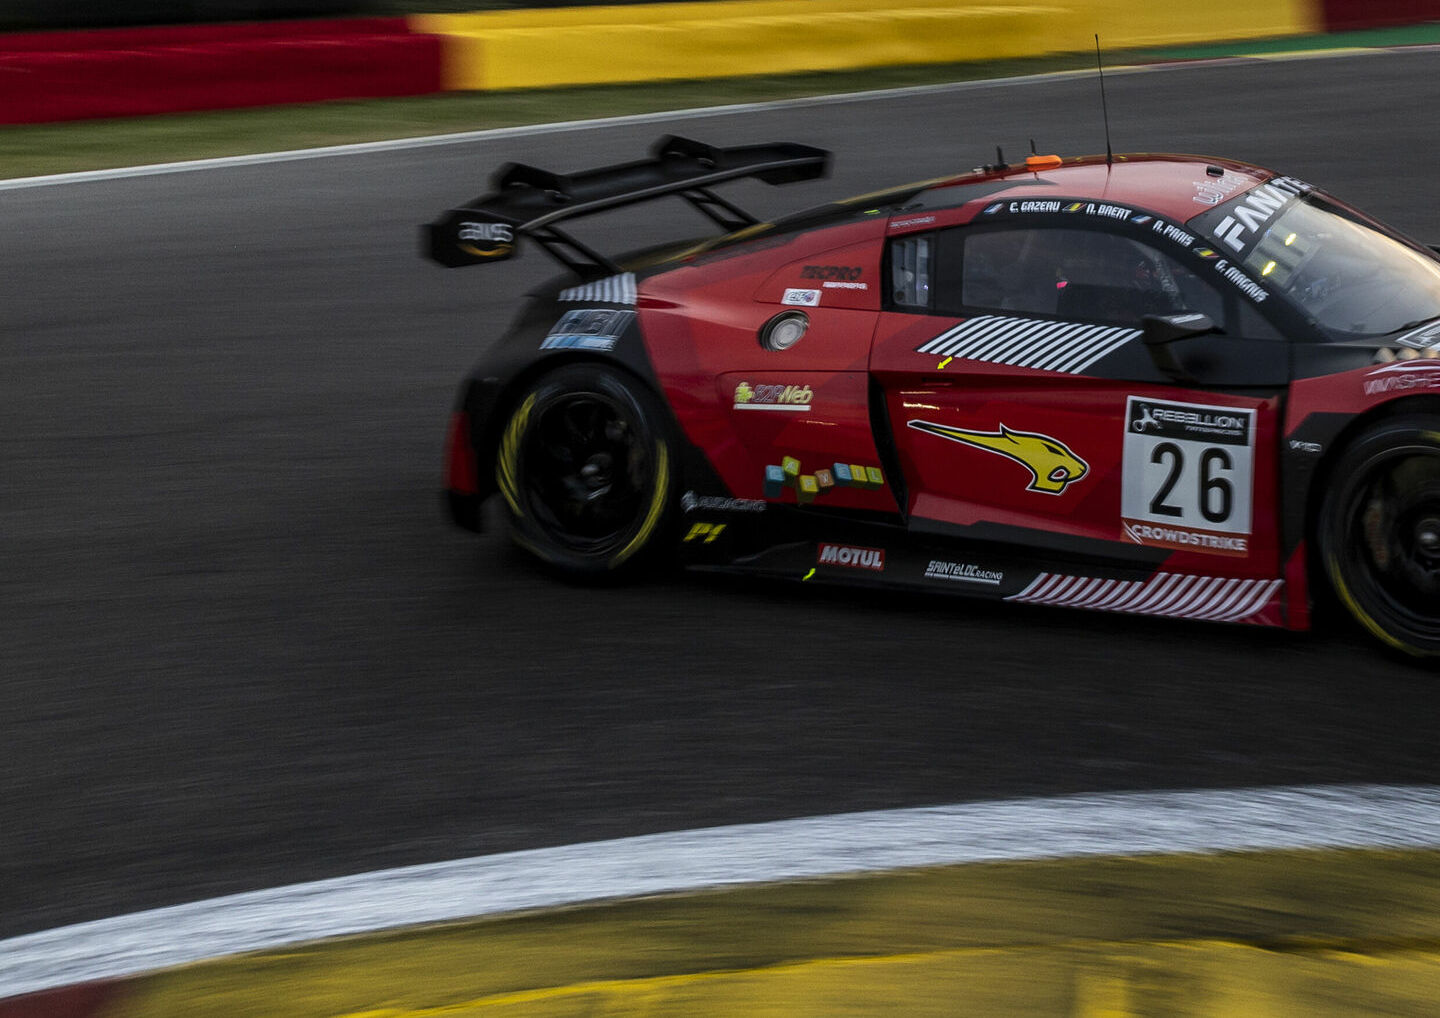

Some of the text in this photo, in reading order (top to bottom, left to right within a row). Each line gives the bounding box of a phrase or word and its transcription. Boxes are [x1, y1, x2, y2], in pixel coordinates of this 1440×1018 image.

[1020, 201, 1060, 213] GAZEAU
[1097, 206, 1132, 221] BAERT
[1162, 224, 1196, 247] PANIS
[800, 265, 862, 281] TECPRO
[1224, 266, 1270, 303] MAGNUS
[1152, 408, 1245, 429] REBELLION
[1150, 441, 1234, 523] 26
[1131, 524, 1248, 551] CROWDSTRIKE
[820, 545, 882, 567] MOTUL
